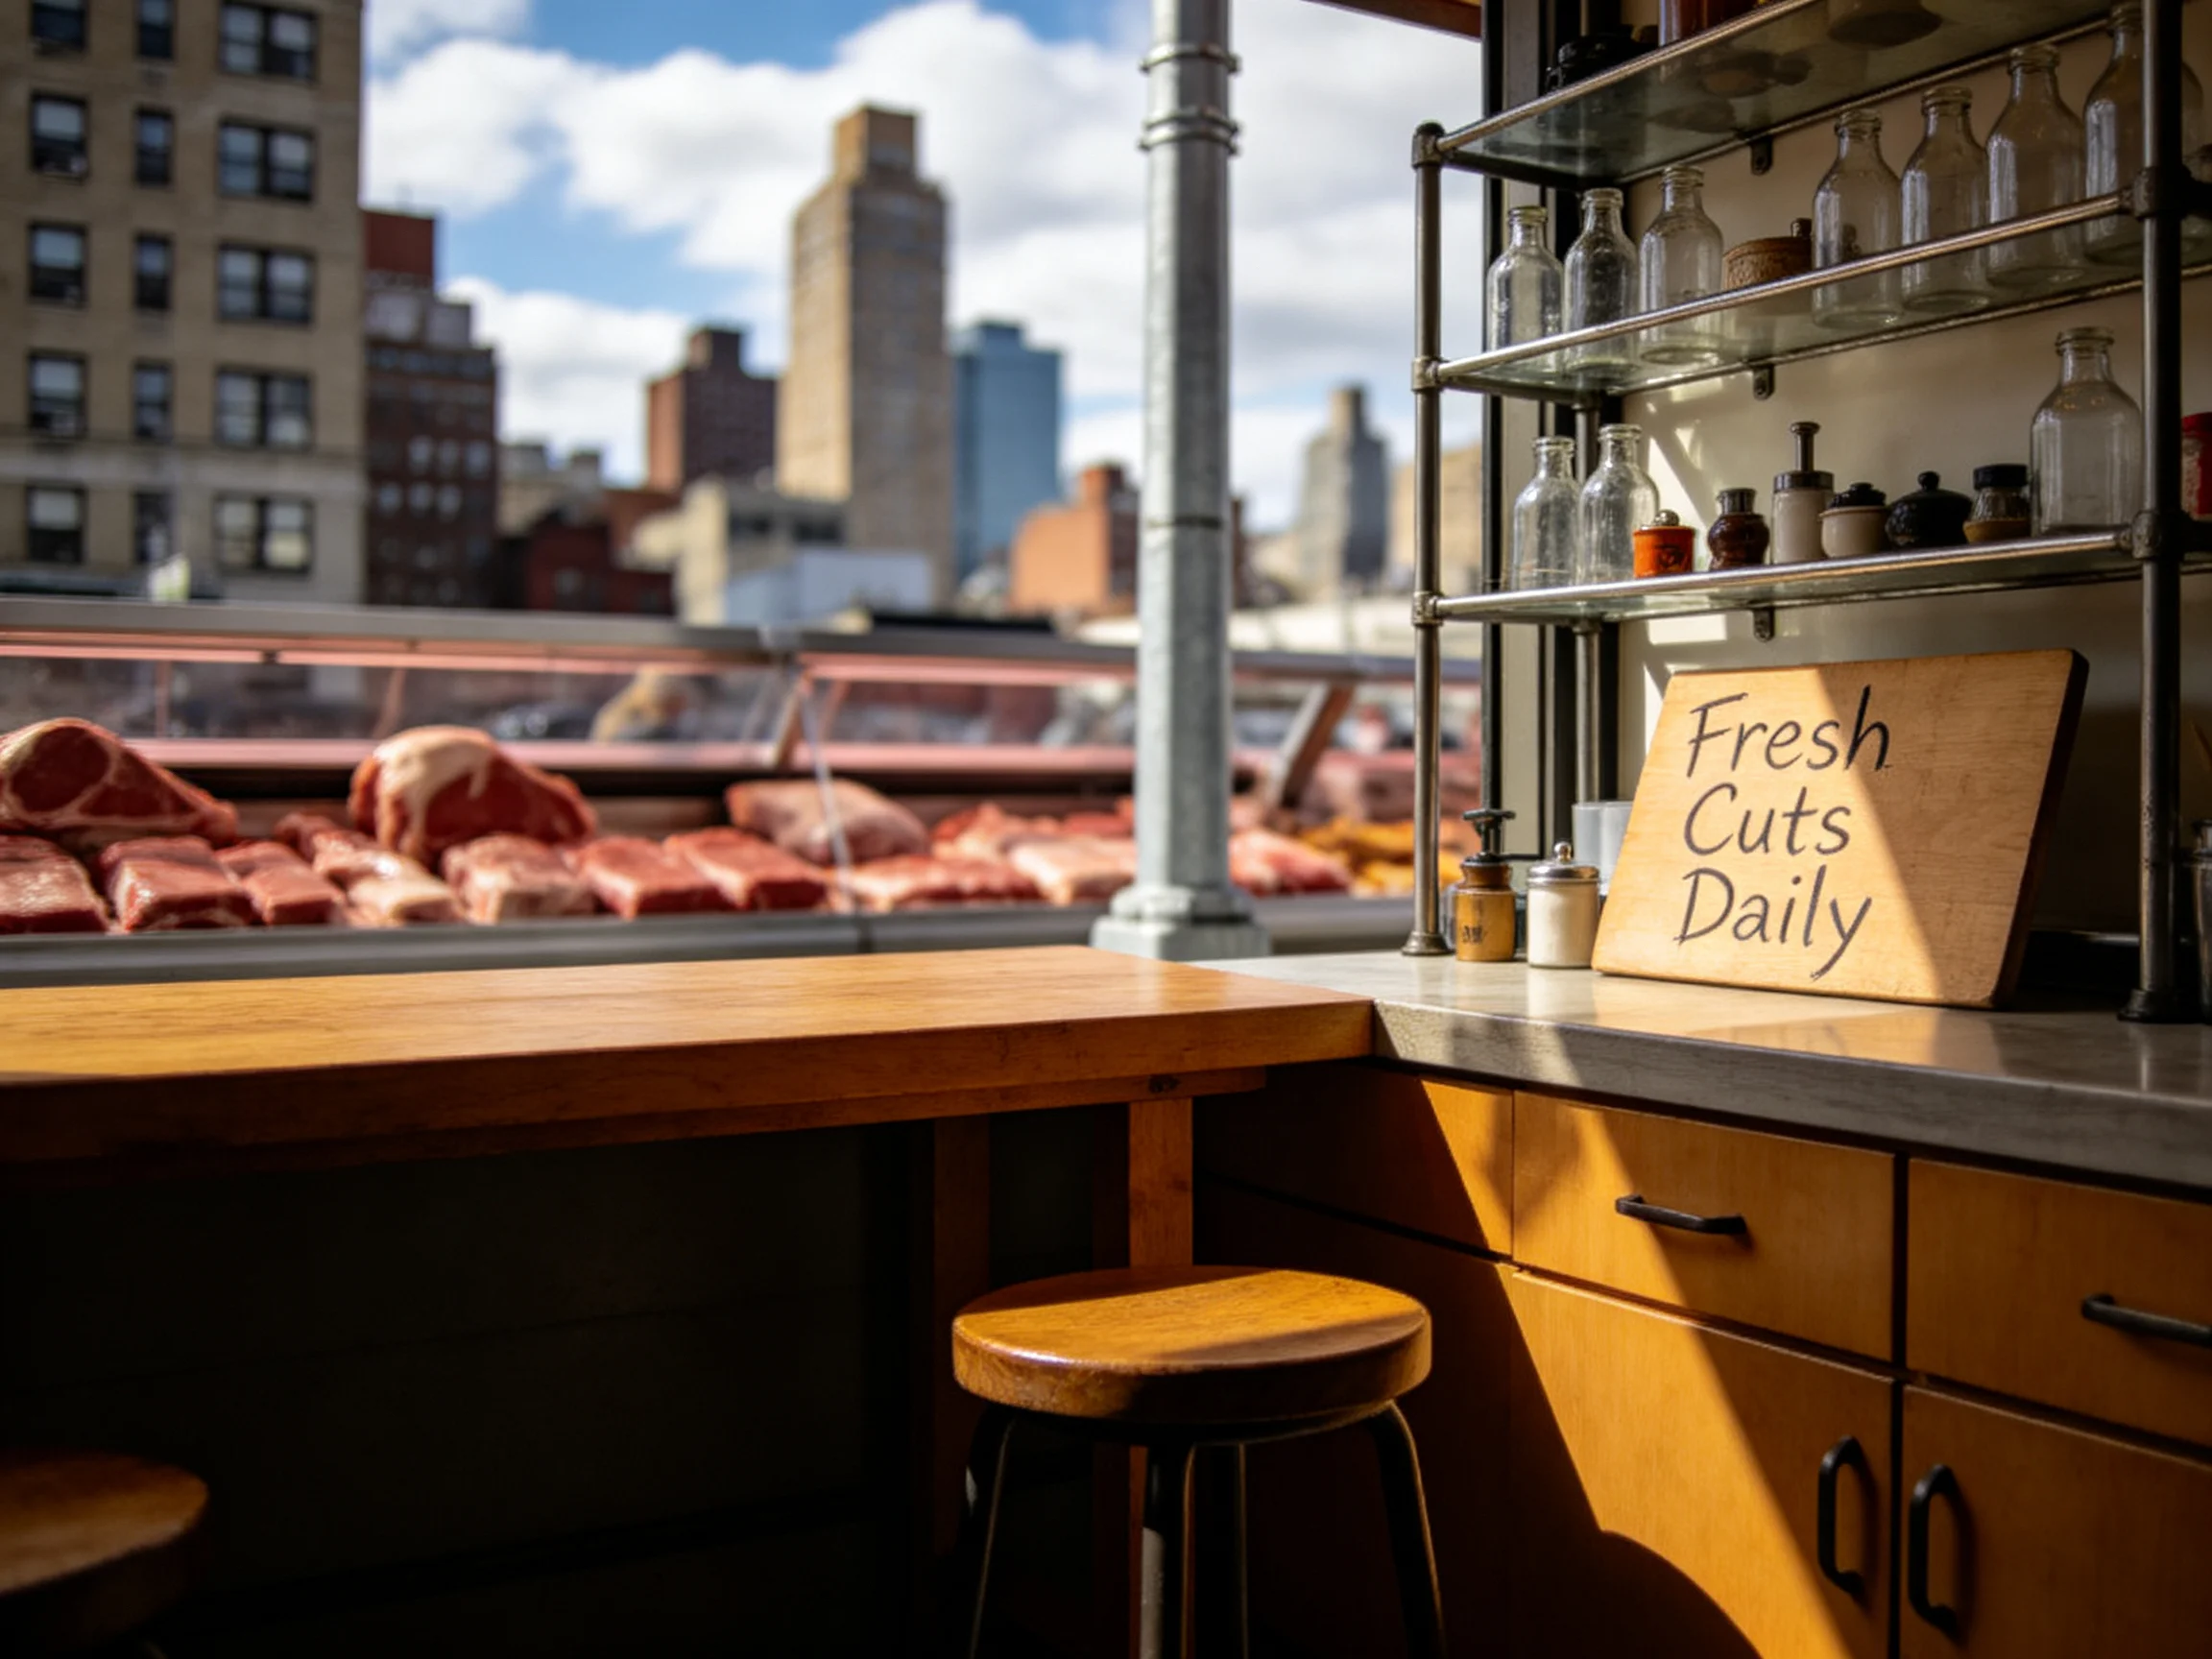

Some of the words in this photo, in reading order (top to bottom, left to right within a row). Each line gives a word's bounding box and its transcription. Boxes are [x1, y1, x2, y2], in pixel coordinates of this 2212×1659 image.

[1686, 685, 1891, 778] Fresh
[1683, 782, 1852, 856] Cuts
[1672, 864, 1872, 980] Daily
